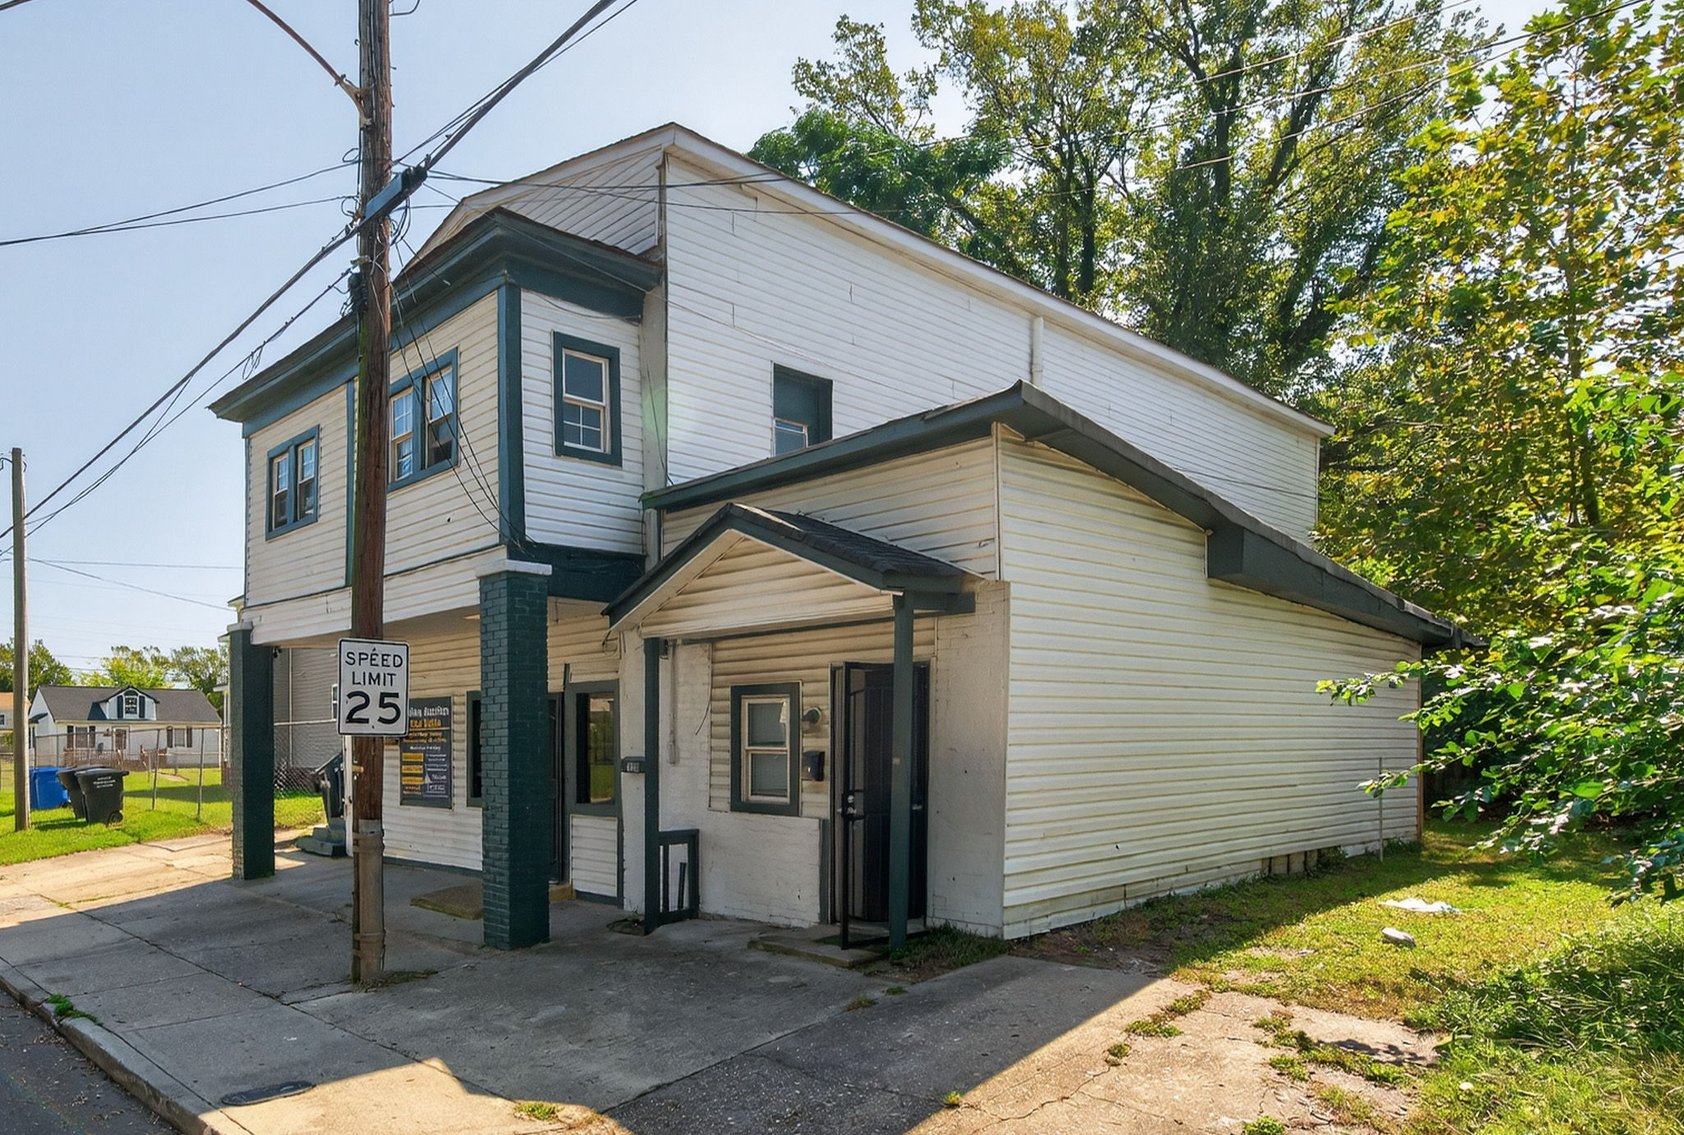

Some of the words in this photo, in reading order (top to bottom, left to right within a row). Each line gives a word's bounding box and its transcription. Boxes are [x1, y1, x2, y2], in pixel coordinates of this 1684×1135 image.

[345, 651, 403, 668] SPEED
[352, 671, 397, 687] LIMIT
[345, 690, 401, 725] 25
